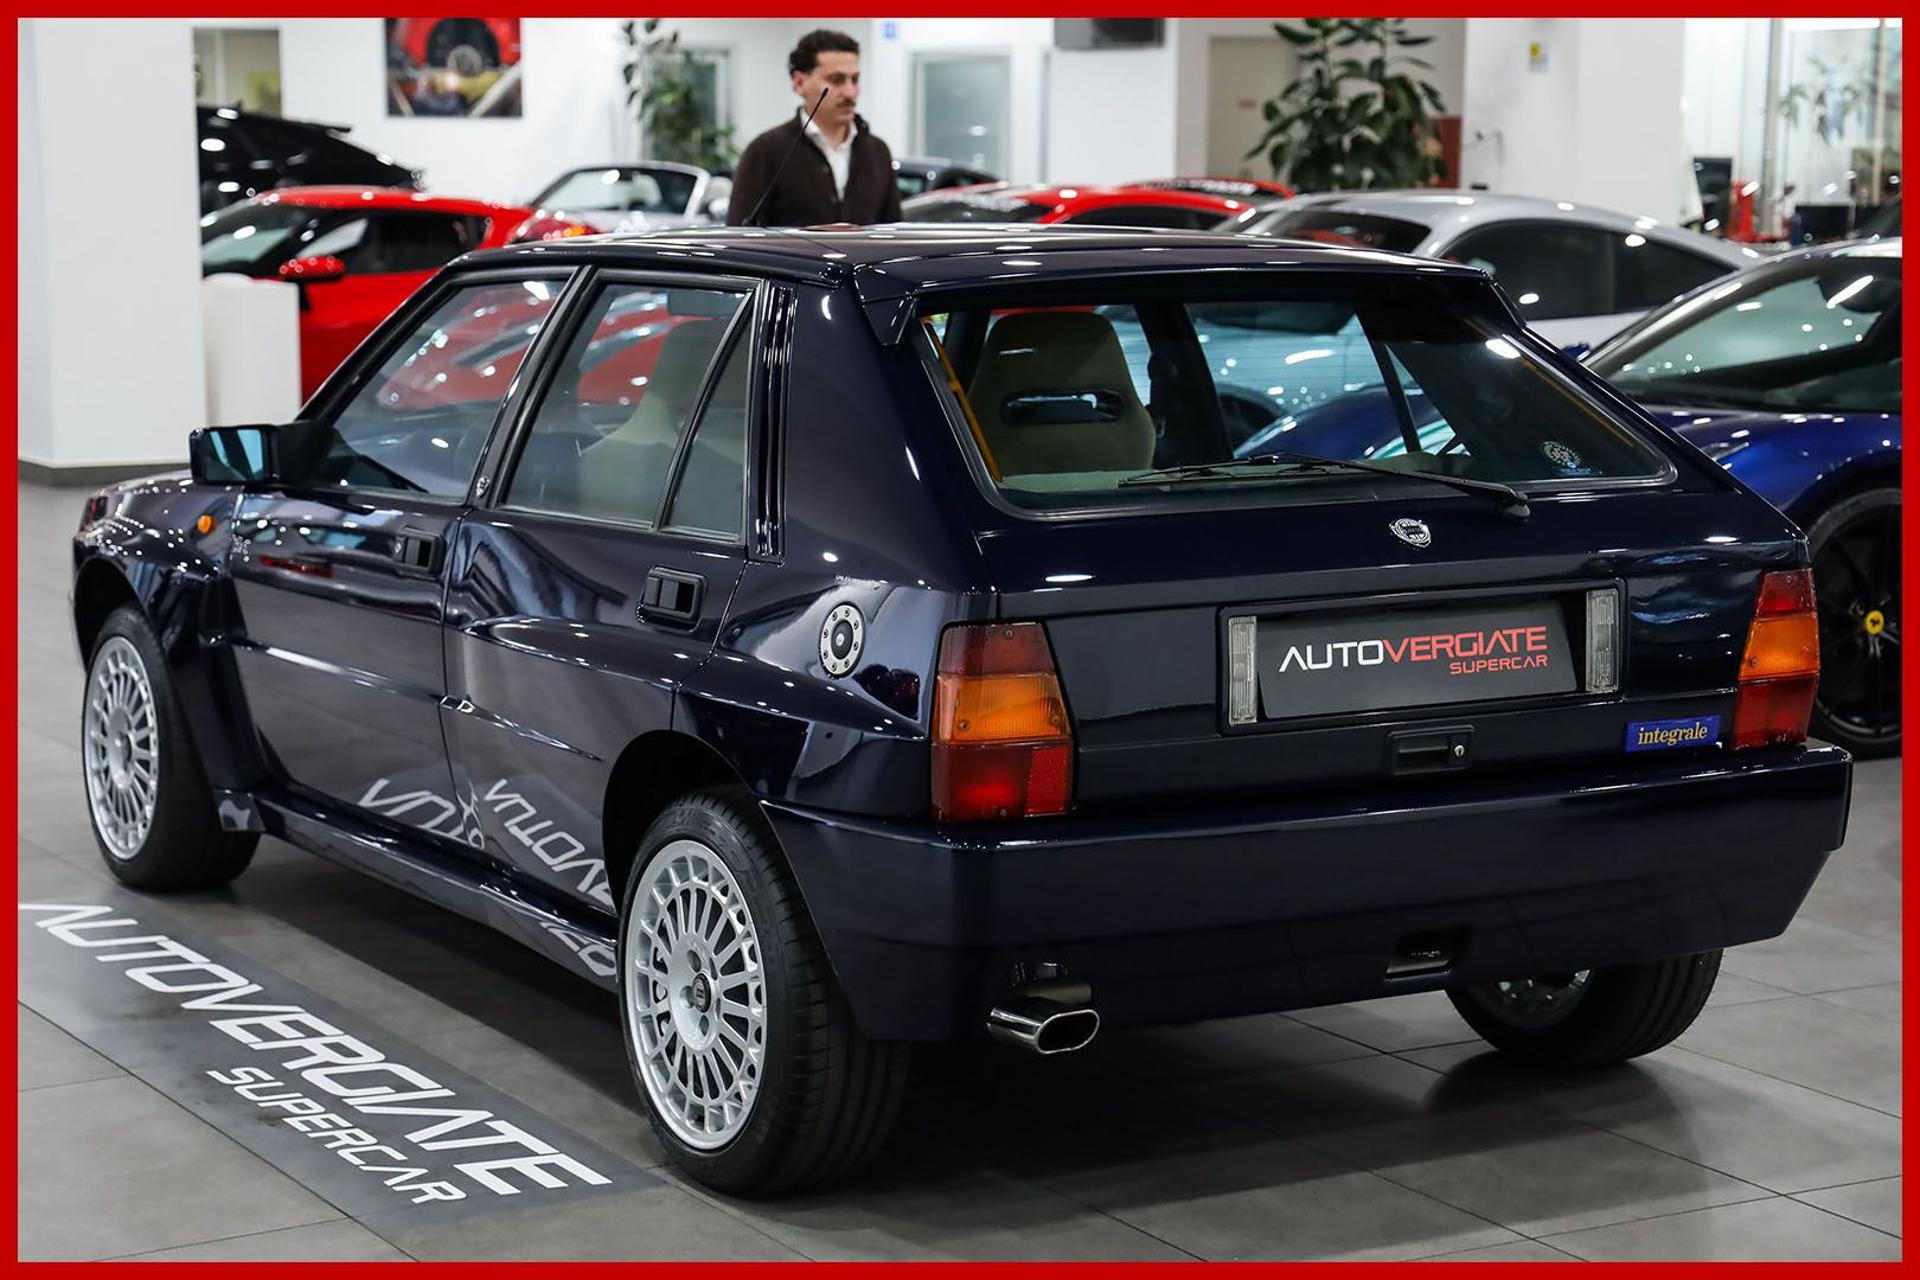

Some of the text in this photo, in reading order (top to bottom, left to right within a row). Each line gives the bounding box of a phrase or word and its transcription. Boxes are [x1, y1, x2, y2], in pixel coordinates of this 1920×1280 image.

[1279, 626, 1548, 673] AUTOVERGIATE
[1450, 654, 1548, 675] SUPERCAR
[1638, 721, 1708, 746] integrale
[18, 903, 612, 1195] AUTOVERGIATE
[207, 1066, 467, 1204] SUPERCAR
